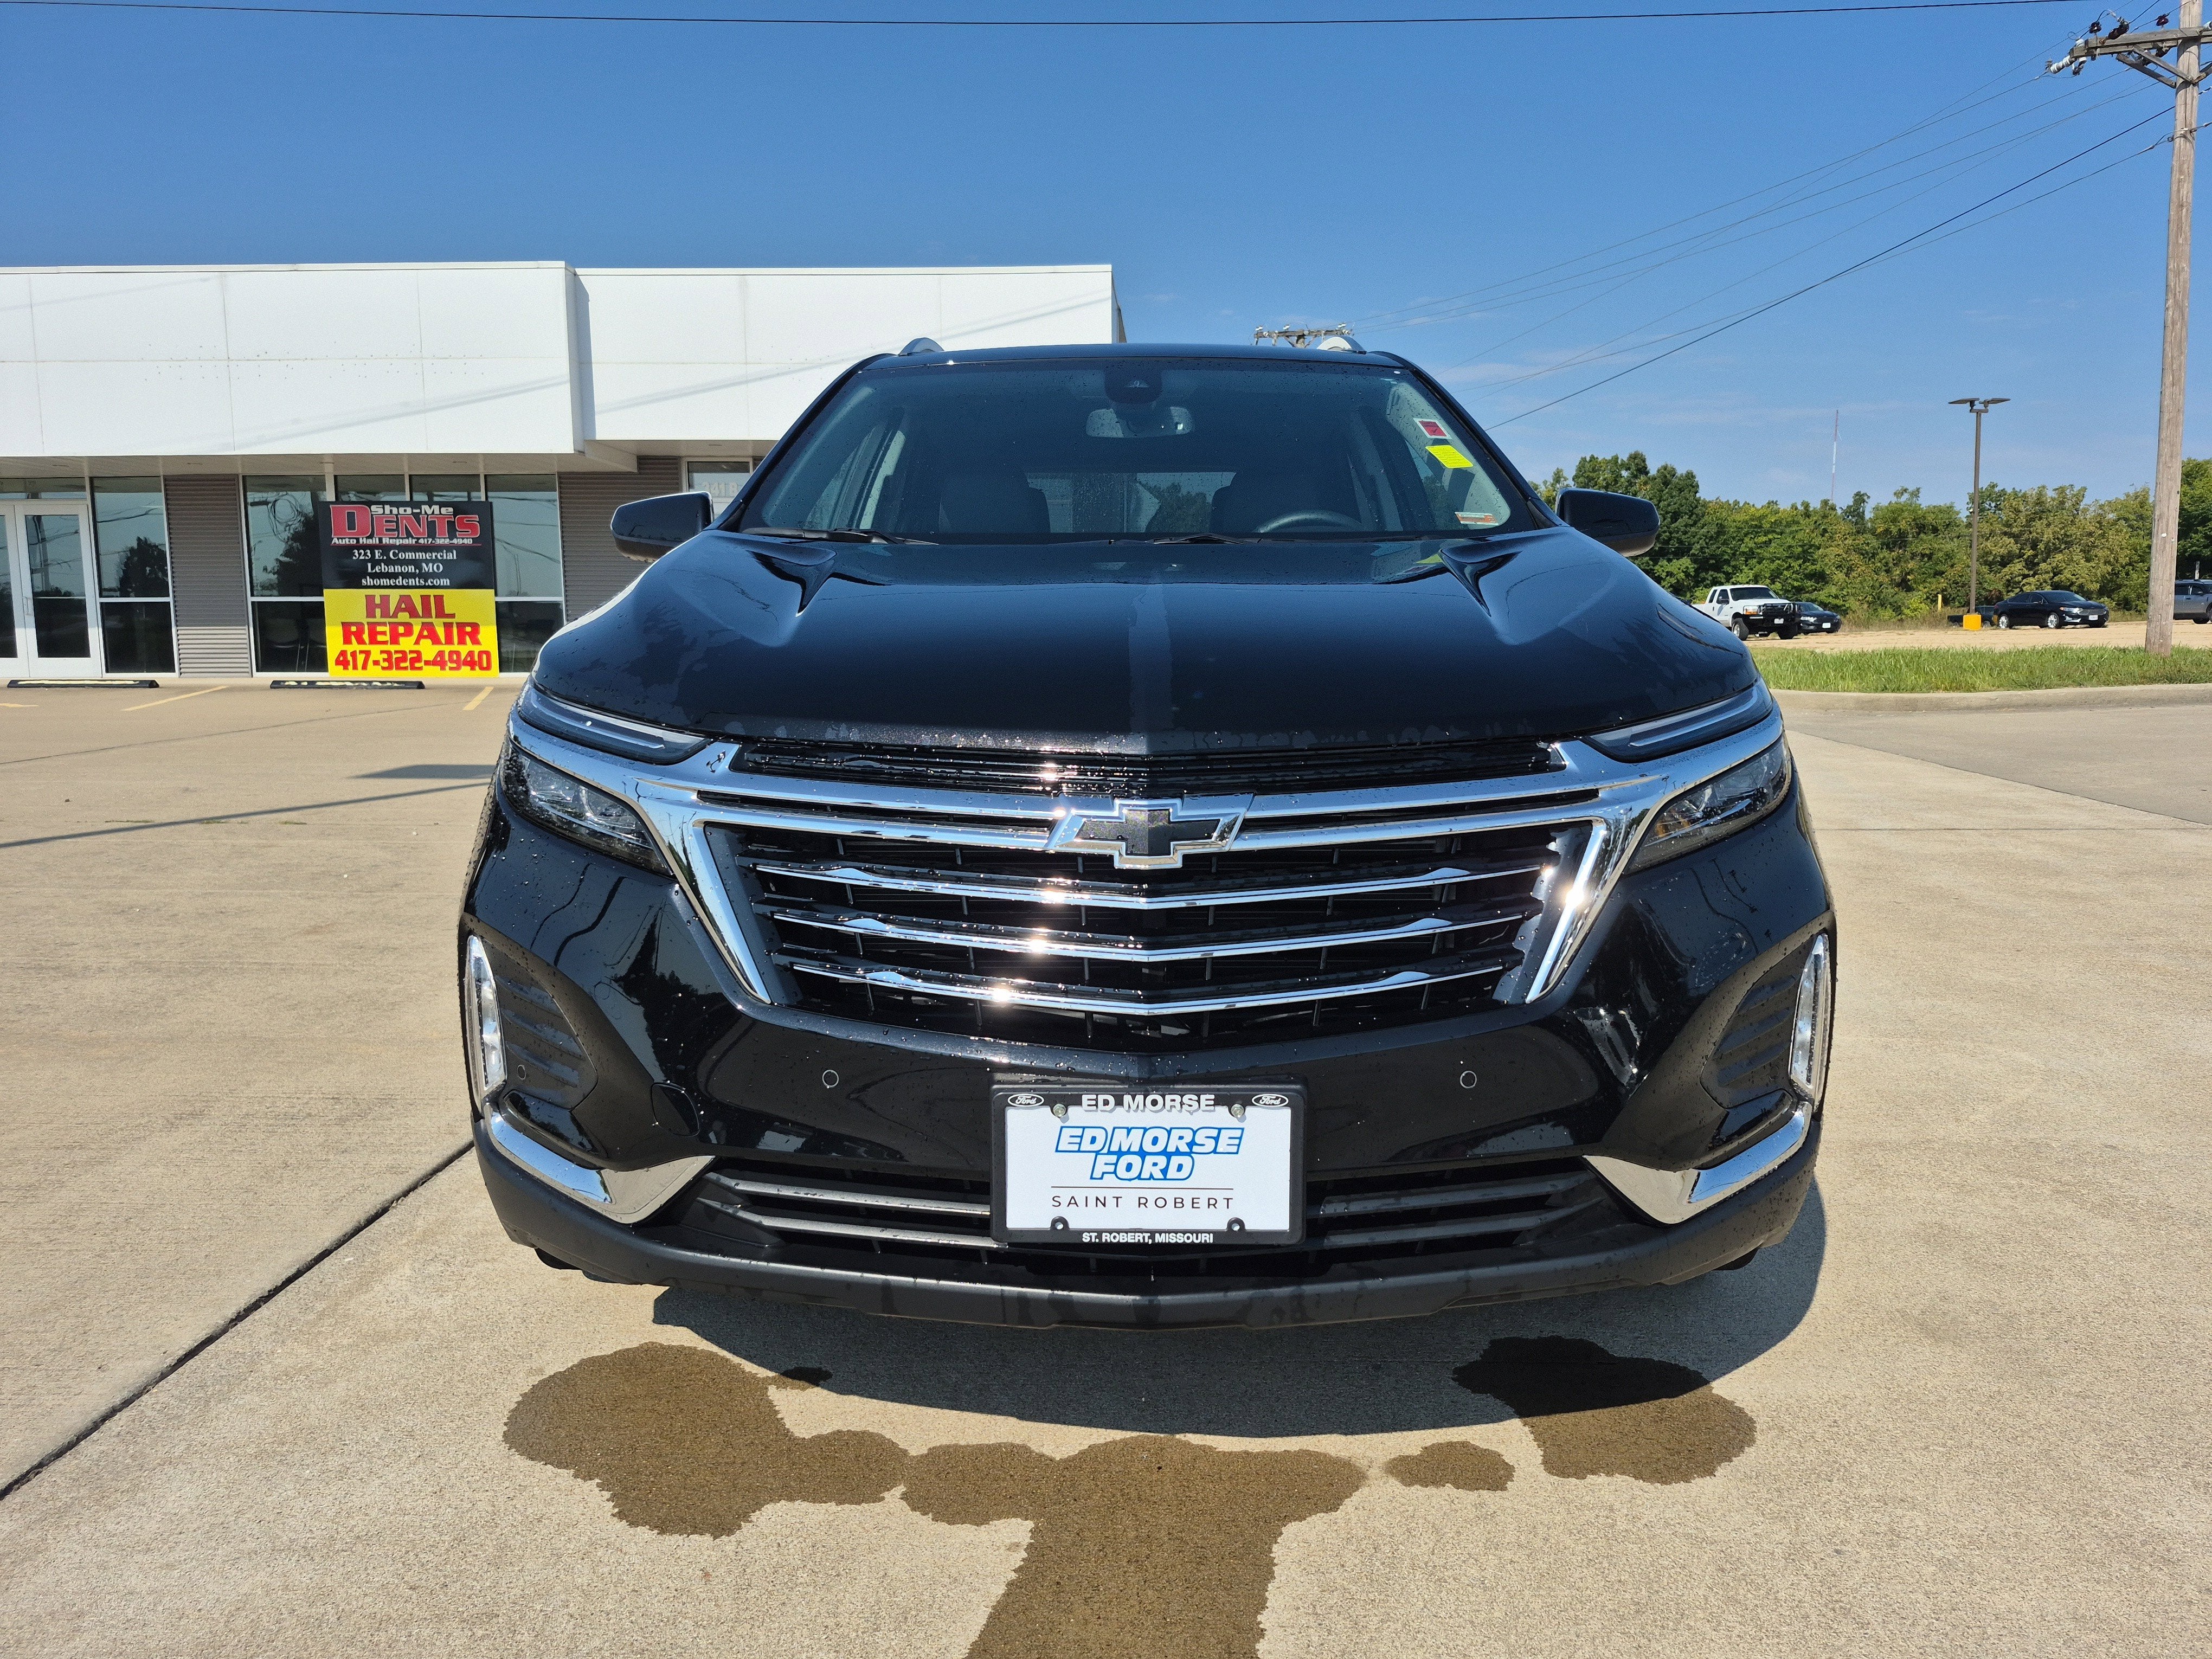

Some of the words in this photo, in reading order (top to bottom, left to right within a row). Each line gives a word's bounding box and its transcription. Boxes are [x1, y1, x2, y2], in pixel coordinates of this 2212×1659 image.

[371, 505, 453, 515] Sho-Me
[330, 505, 480, 538] DENTS
[382, 537, 417, 545] Repair
[352, 550, 371, 560] 323
[375, 550, 387, 560] E.
[389, 549, 456, 560] Commercial
[367, 563, 419, 575] Lebanon,
[422, 563, 443, 573] MO
[362, 576, 450, 586] shomedents.com
[365, 595, 455, 619] HAIL
[341, 622, 482, 645] REPAIR
[335, 650, 492, 671] 417-322-4940
[1015, 1096, 1037, 1104] Ford
[1082, 1094, 1115, 1111] ED
[1122, 1094, 1216, 1111] MORSE
[1259, 1095, 1282, 1105] Ford
[1055, 1126, 1108, 1153] ED
[1108, 1126, 1244, 1155] MORSE
[1090, 1154, 1195, 1181] FORD
[1052, 1195, 1123, 1208] SAINT
[1137, 1196, 1234, 1210] ROBERT
[1082, 1233, 1099, 1243] ST.
[1102, 1233, 1152, 1245] ROBERT,
[1155, 1233, 1213, 1243] MISSOURI
